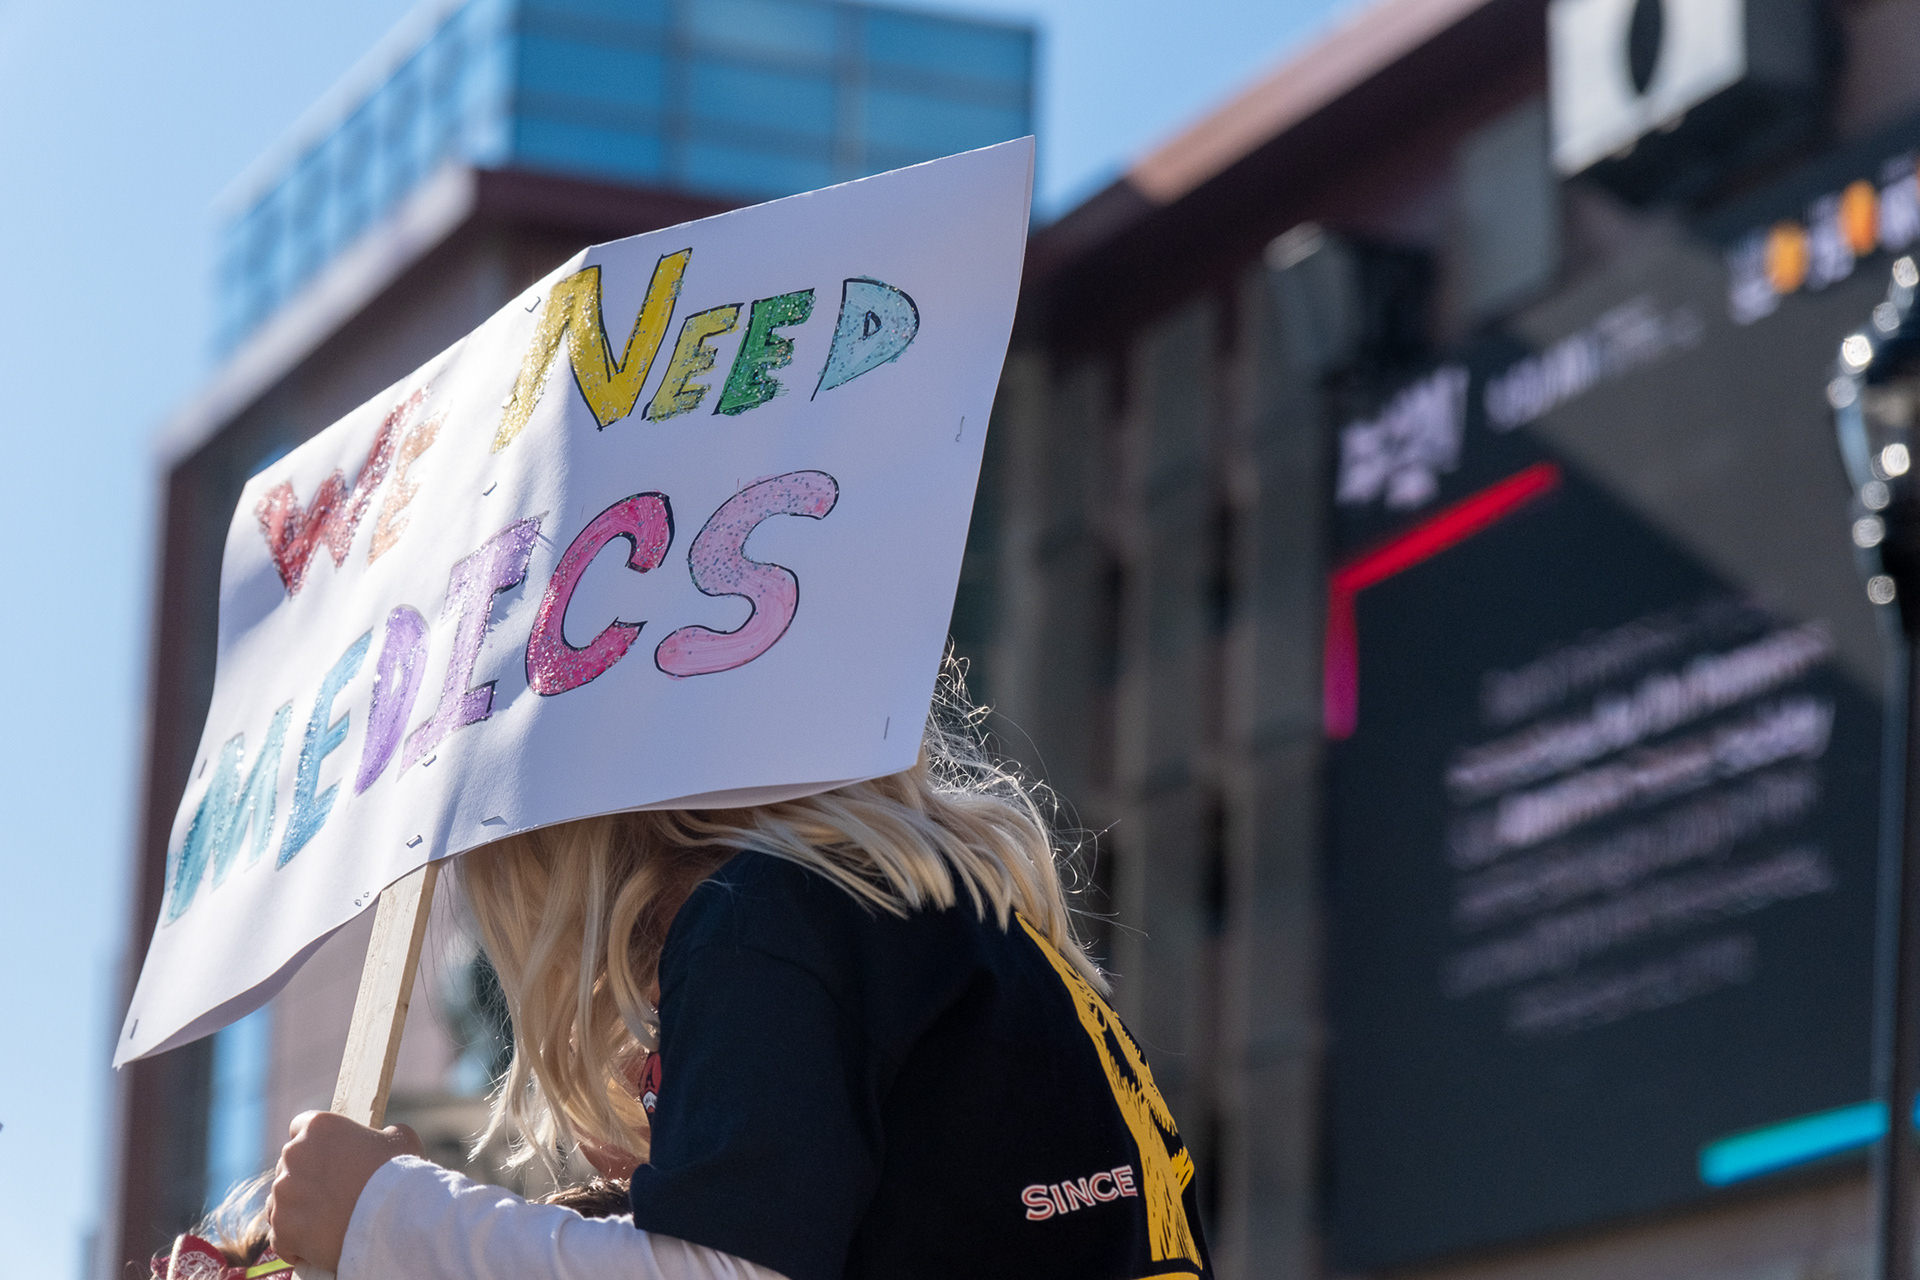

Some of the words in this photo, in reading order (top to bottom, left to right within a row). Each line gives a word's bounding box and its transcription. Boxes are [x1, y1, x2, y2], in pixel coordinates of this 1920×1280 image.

[255, 385, 447, 598] WE
[492, 247, 920, 452] NEED
[165, 469, 840, 924] MEDICS
[1021, 1164, 1138, 1220] SINCE
